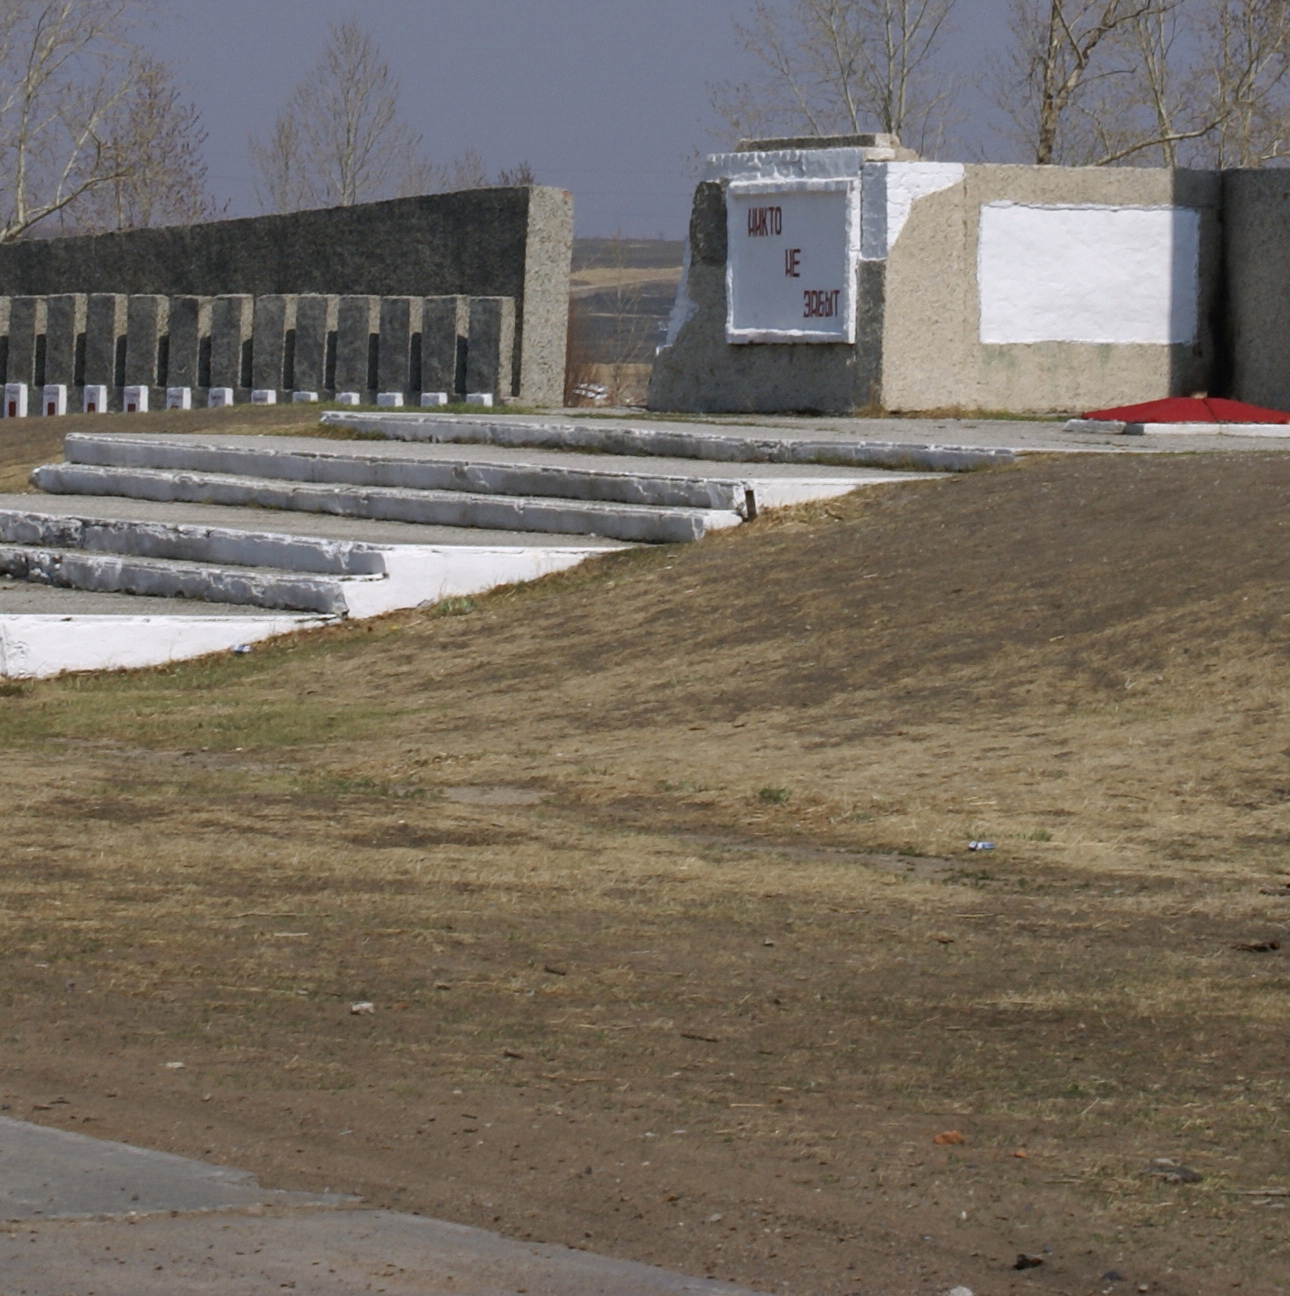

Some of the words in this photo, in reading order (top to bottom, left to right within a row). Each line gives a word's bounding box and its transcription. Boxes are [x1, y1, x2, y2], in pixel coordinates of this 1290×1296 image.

[748, 206, 782, 237] НИКТО
[785, 248, 801, 278] НЕ
[803, 290, 840, 318] ЗАБЫТ
